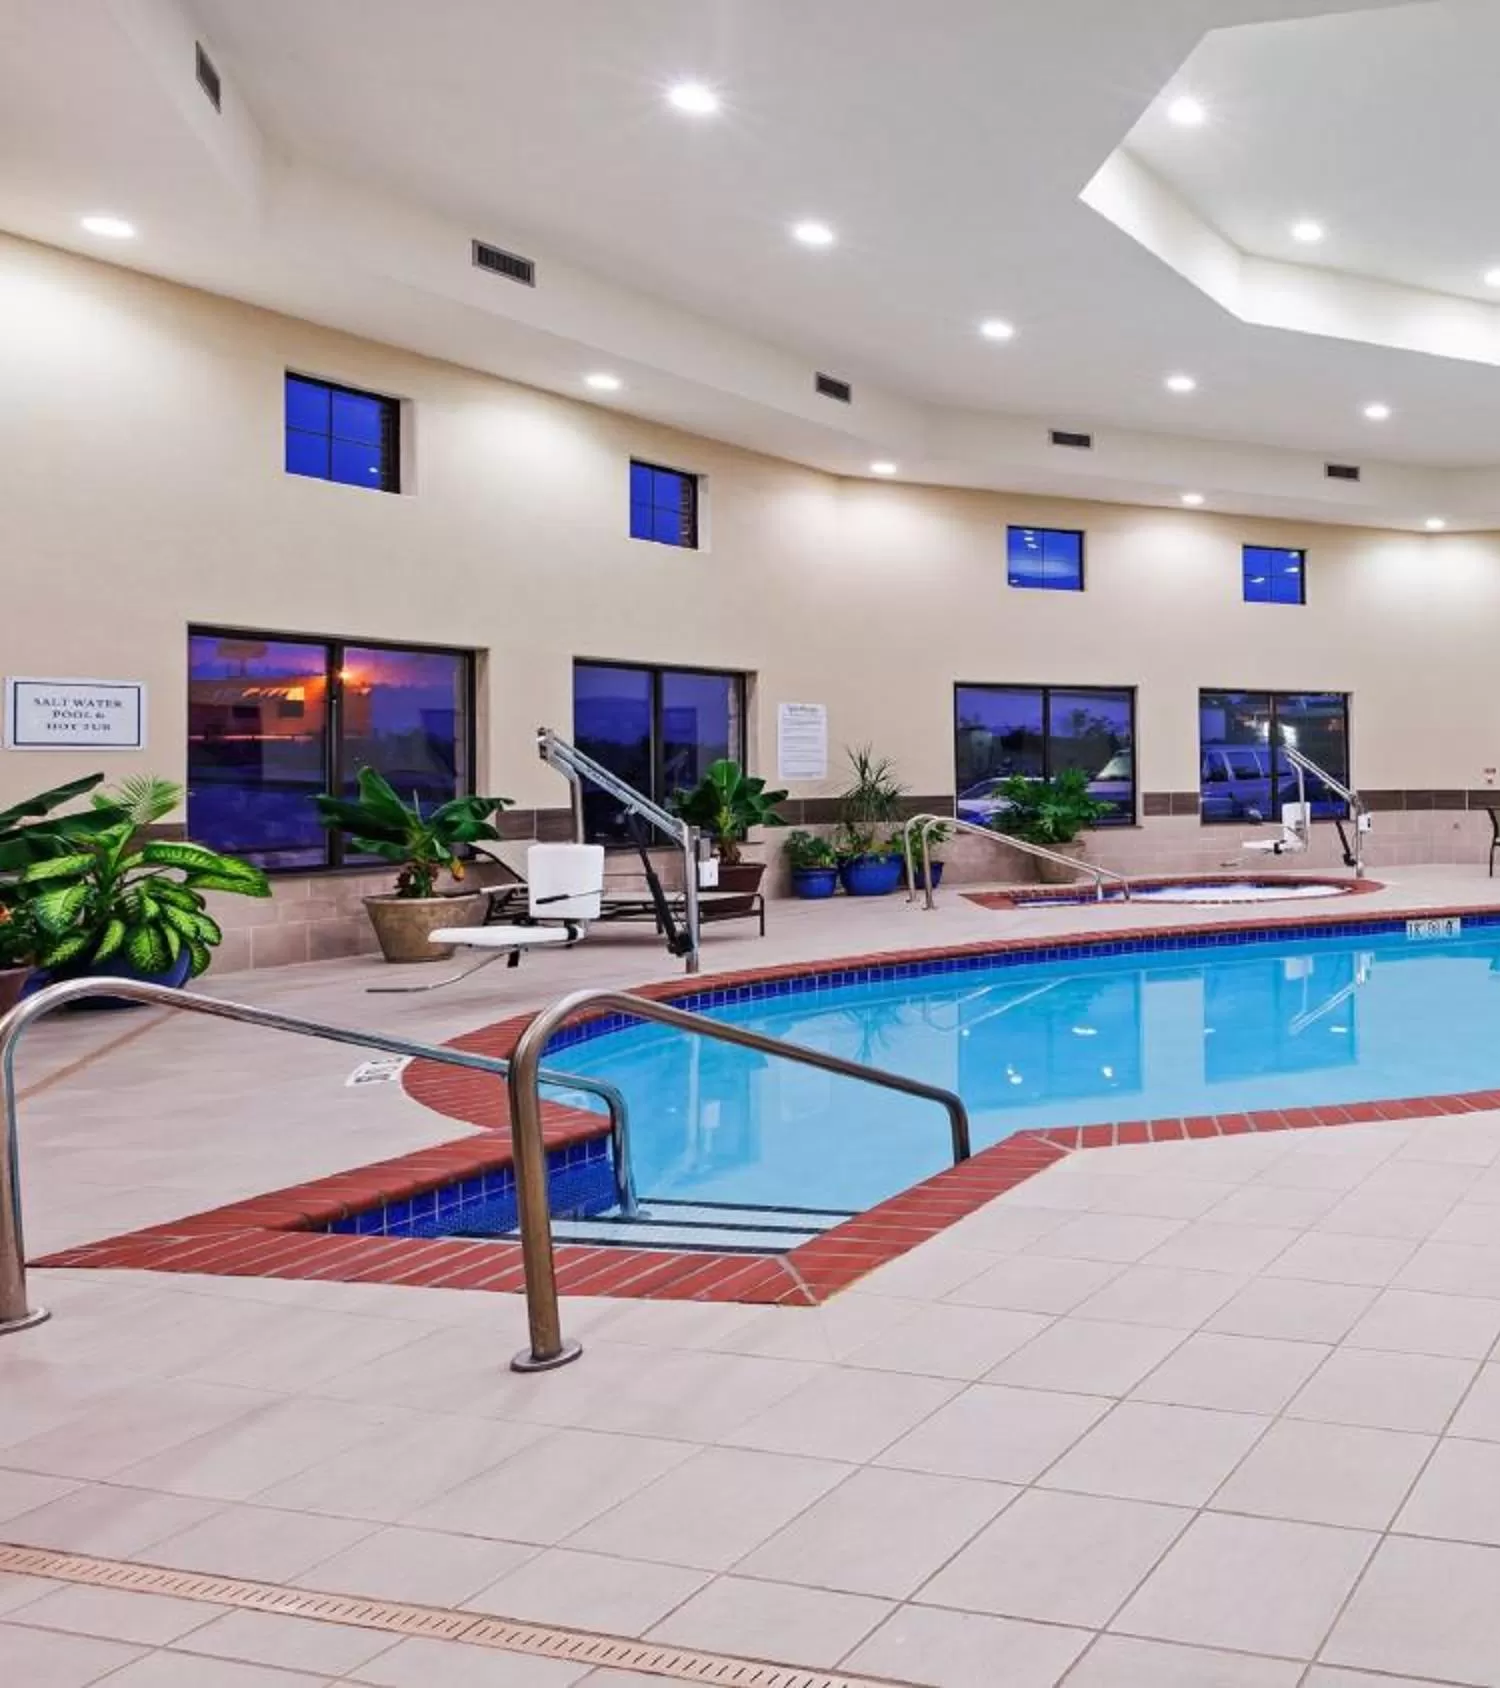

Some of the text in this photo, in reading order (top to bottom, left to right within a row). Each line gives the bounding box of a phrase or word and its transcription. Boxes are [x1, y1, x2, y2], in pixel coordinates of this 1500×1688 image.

[33, 698, 123, 708] SALT WATER
[52, 710, 92, 719] POOL
[47, 723, 77, 731] HOT
